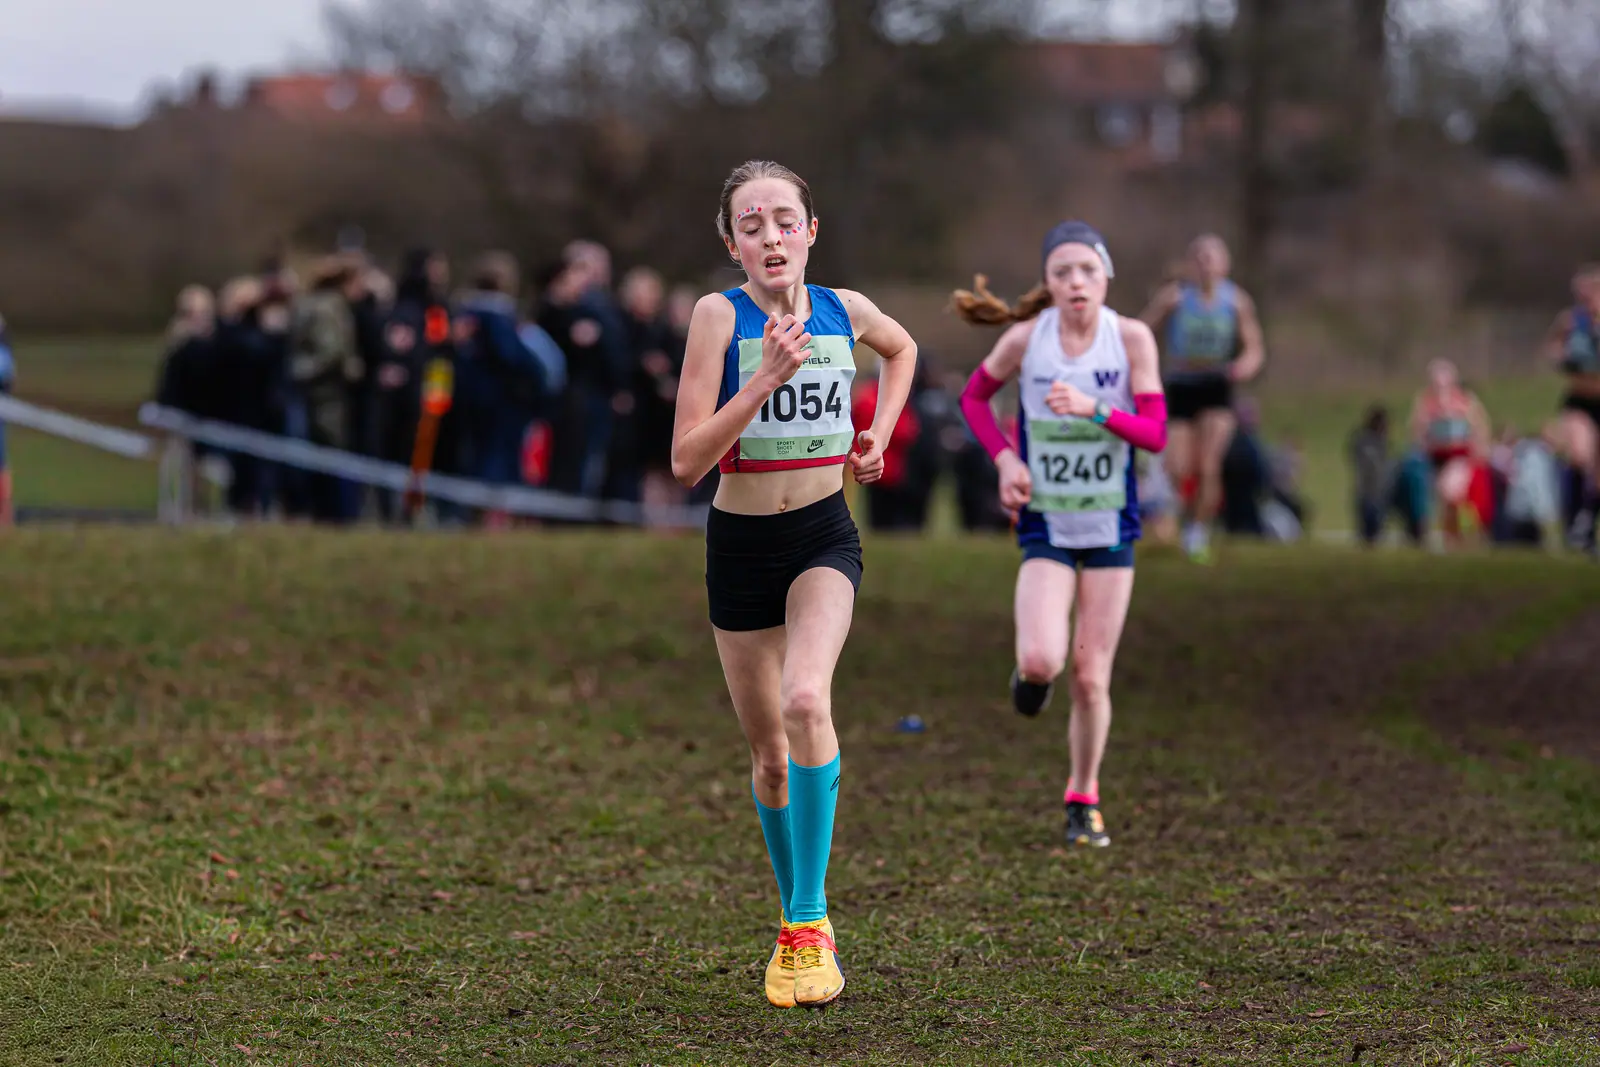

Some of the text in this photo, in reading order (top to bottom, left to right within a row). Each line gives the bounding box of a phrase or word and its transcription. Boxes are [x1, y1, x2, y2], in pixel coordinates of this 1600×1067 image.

[1094, 370, 1119, 387] W
[810, 439, 824, 447] RUN
[1040, 453, 1112, 482] 1240
